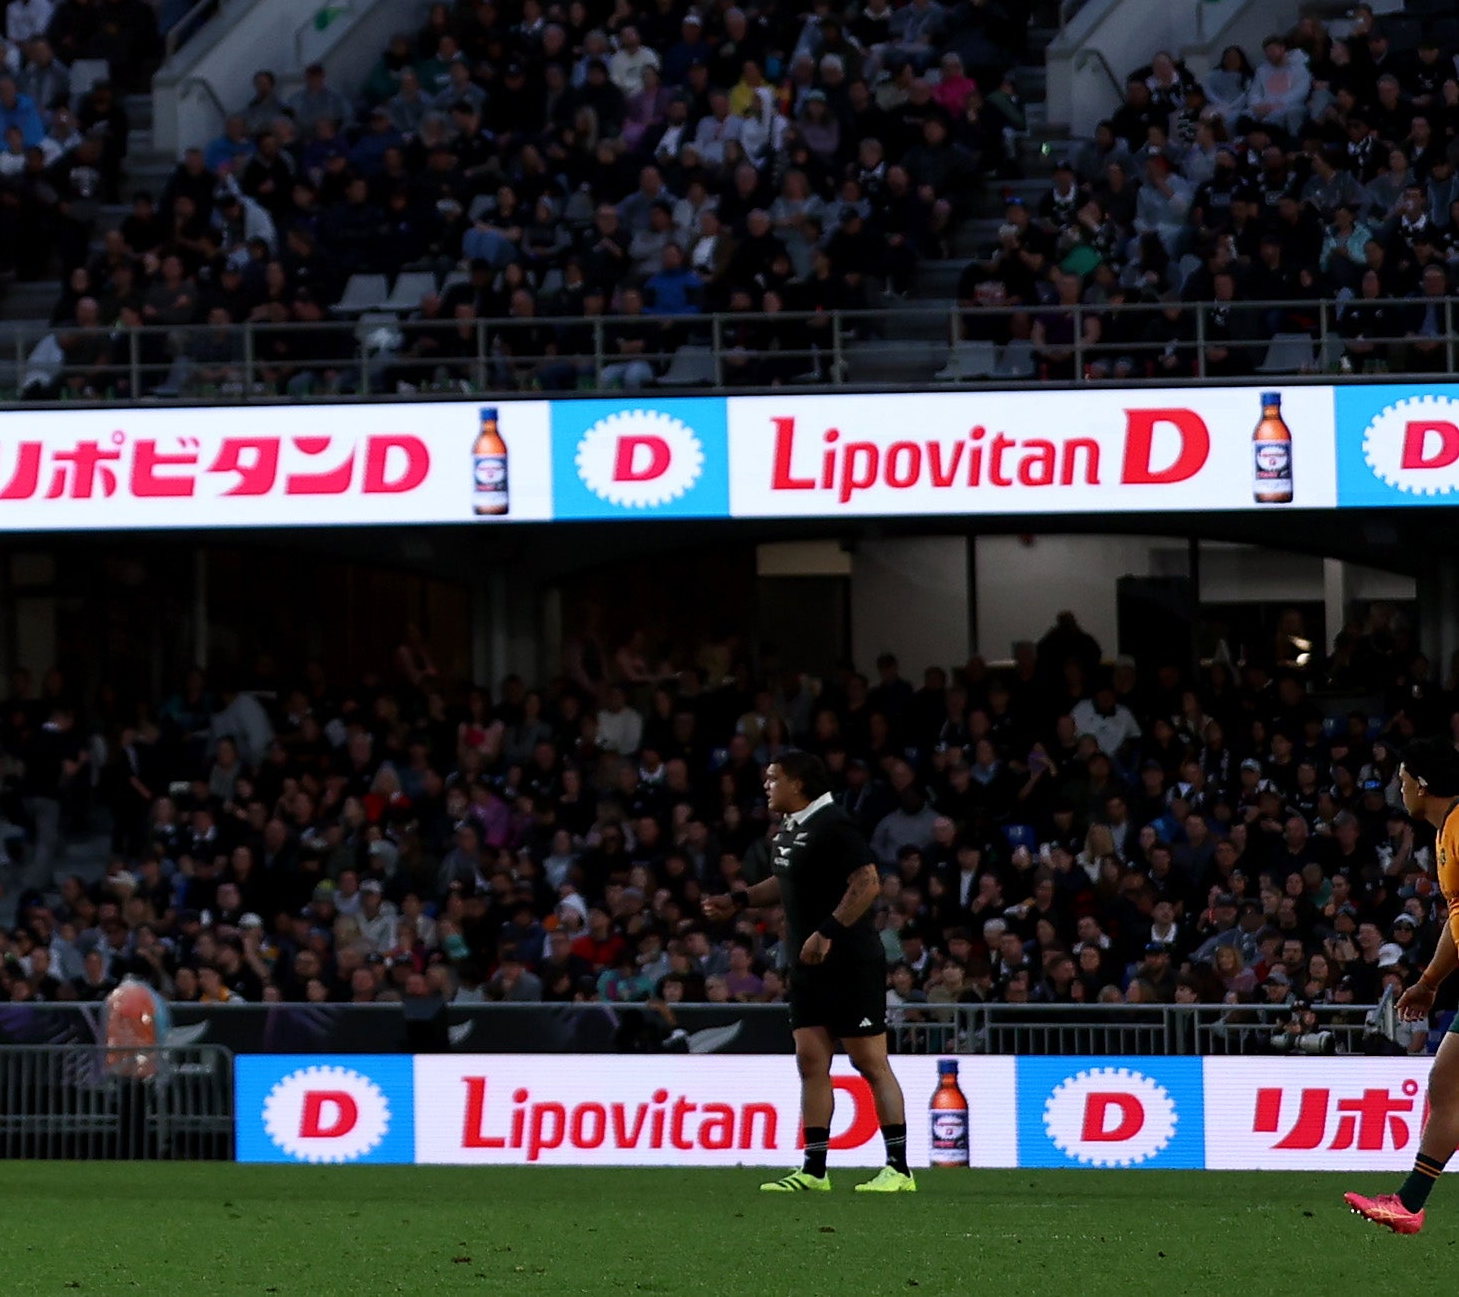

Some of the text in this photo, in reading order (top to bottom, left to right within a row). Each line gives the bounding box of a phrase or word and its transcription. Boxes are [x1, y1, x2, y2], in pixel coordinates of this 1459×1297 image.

[613, 435, 672, 482] D
[772, 417, 1101, 504] Lipovitan
[1121, 408, 1211, 485] D
[1400, 420, 1459, 470] D
[299, 1090, 359, 1139] D
[462, 1076, 777, 1162] Lipovitan
[1081, 1092, 1145, 1142] D
[1253, 1078, 1431, 1151] リポ
